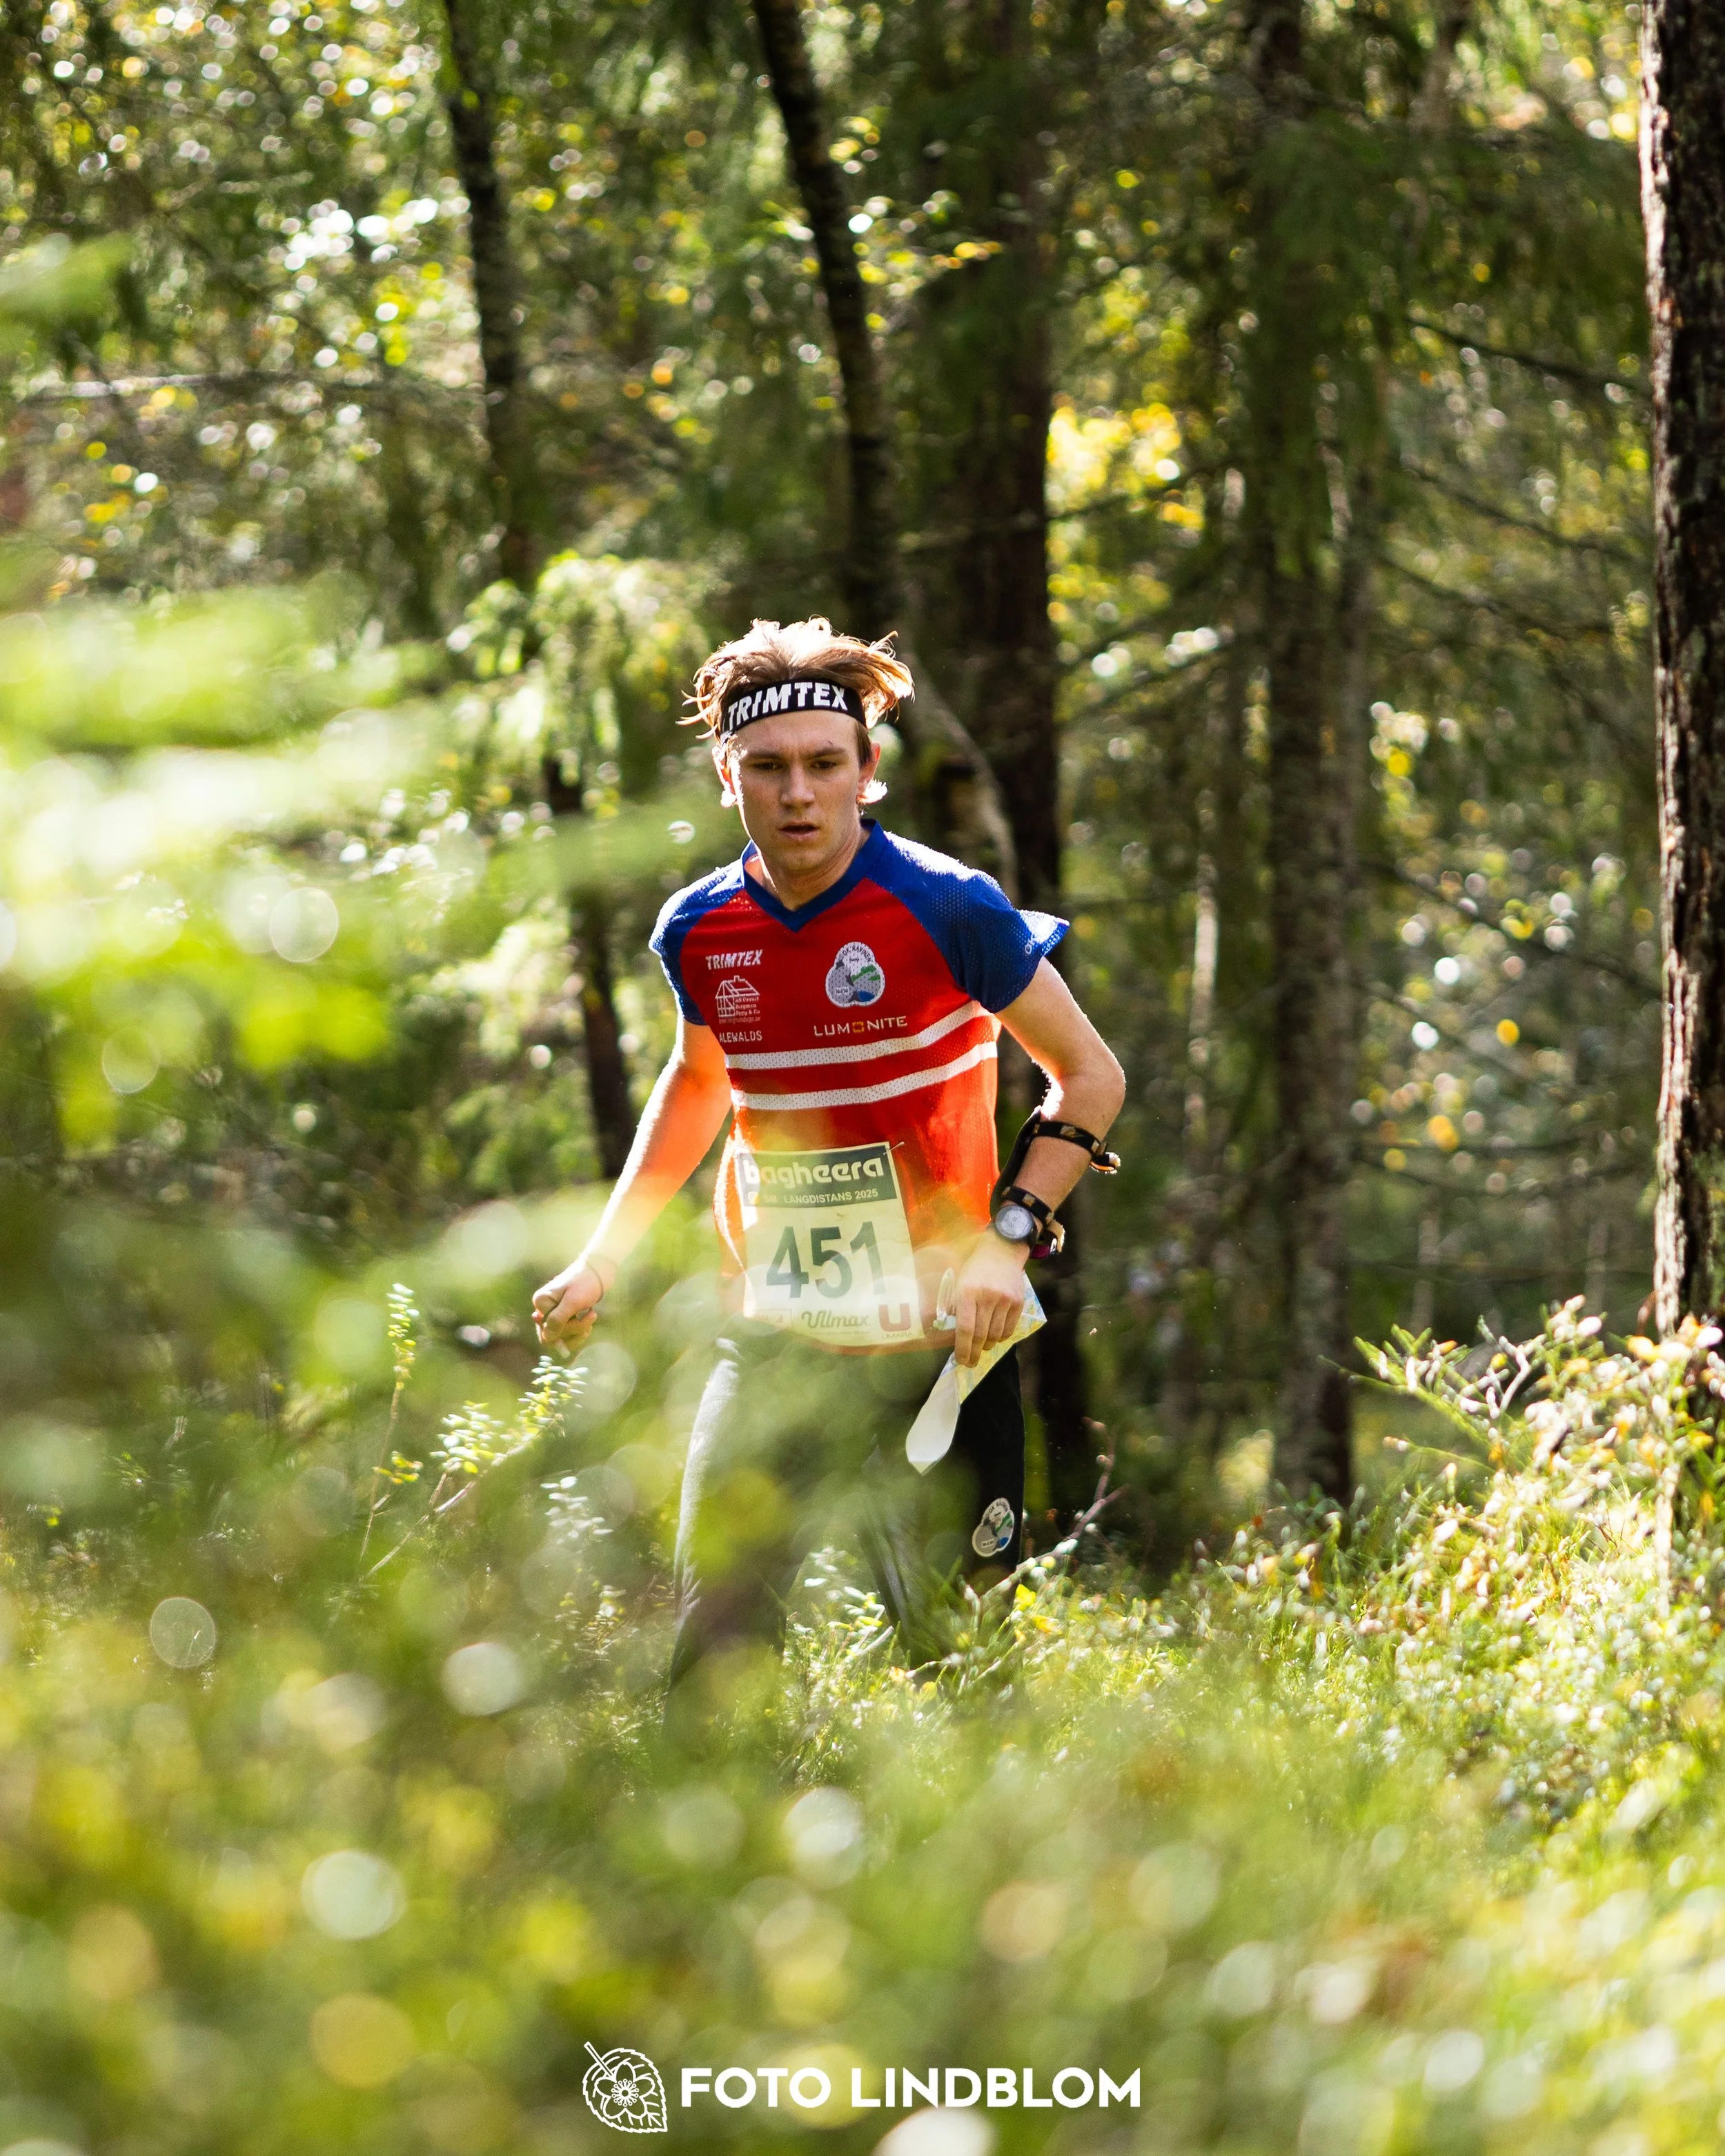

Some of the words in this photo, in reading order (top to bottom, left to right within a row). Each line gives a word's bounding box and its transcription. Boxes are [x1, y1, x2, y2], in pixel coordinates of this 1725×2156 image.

[728, 682, 848, 731] TRIMTEX
[705, 949, 764, 970] TRIMTEX
[842, 946, 851, 956] OK
[719, 1030, 762, 1042] ALEWALDS
[814, 1016, 907, 1037] LUMONITE
[742, 1157, 884, 1189] bagheera
[855, 1188, 878, 1200] 2025
[766, 1220, 885, 1299] 451
[801, 1309, 869, 1329] Ullmax
